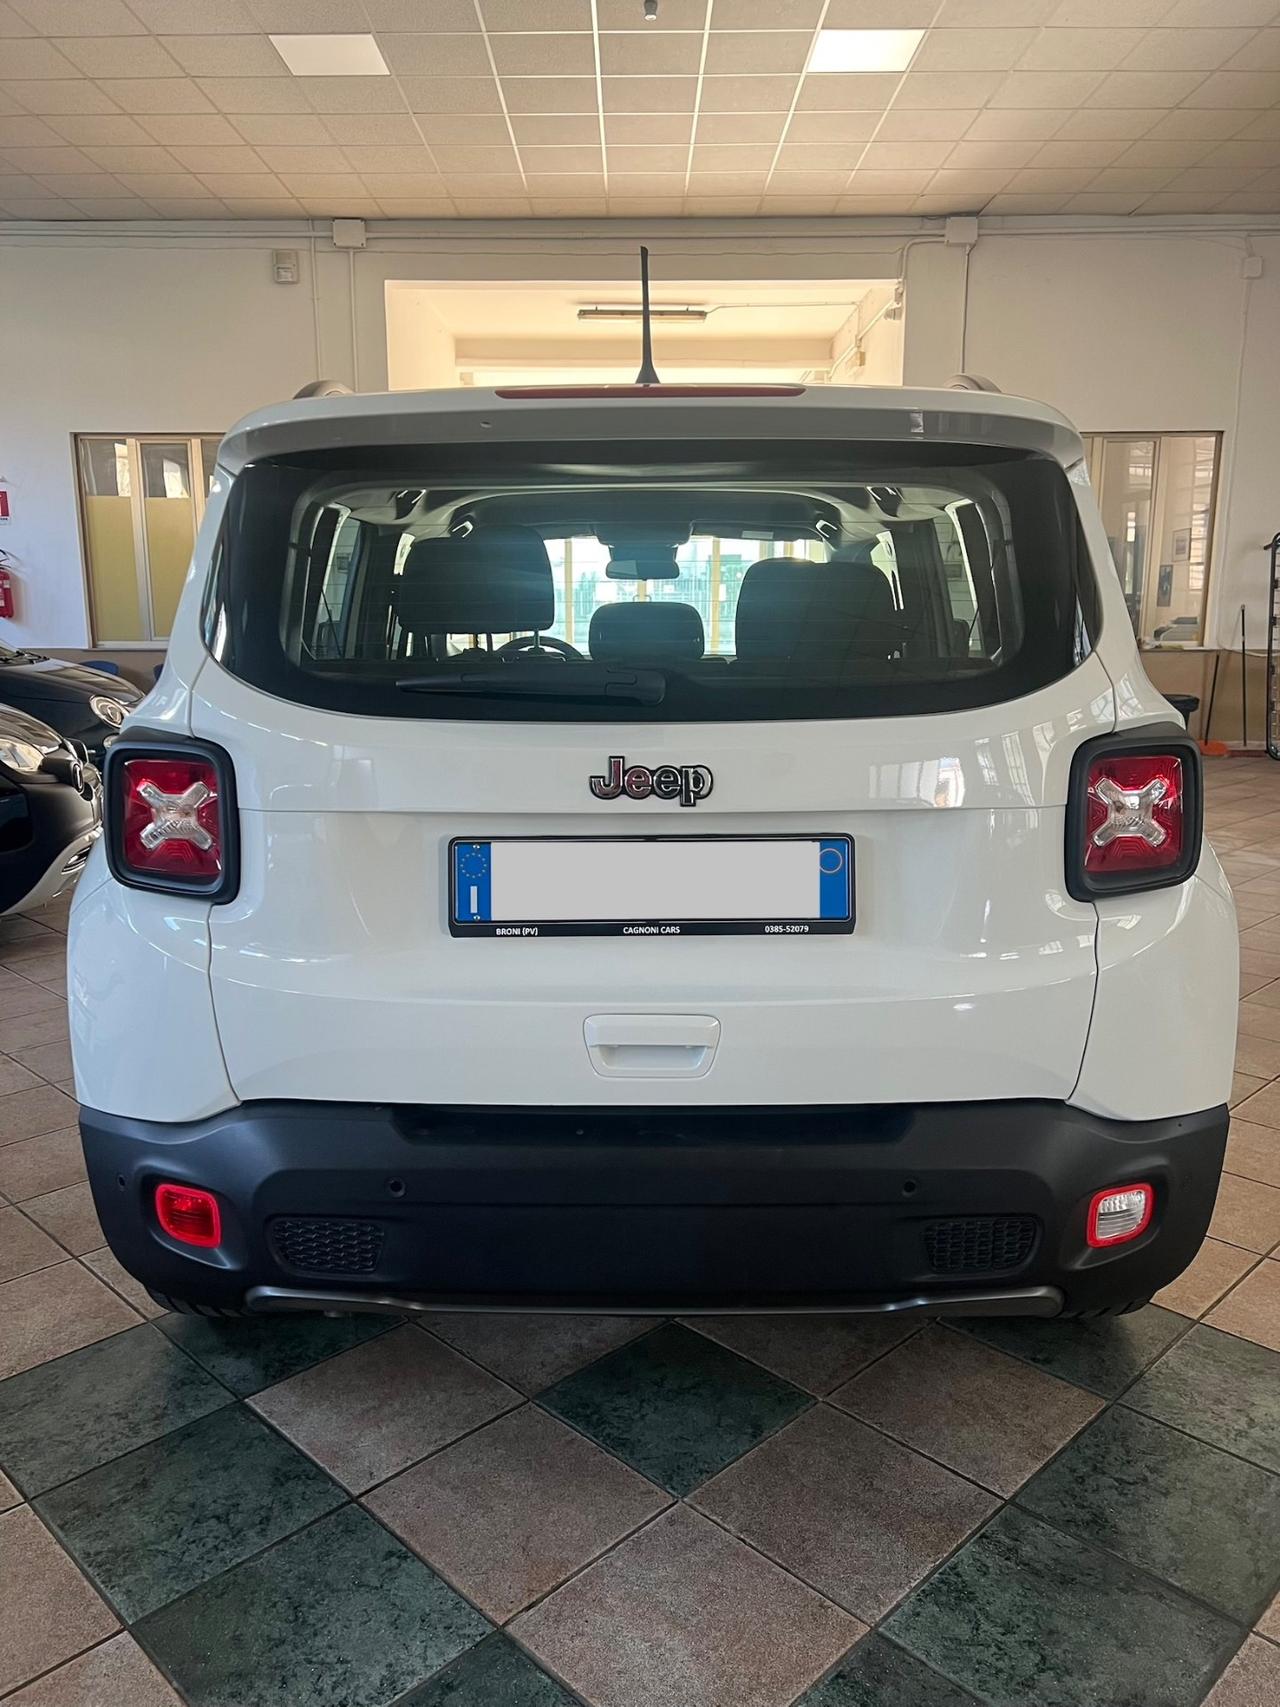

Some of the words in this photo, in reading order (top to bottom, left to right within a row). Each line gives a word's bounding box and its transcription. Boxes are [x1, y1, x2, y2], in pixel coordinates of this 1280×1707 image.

[589, 756, 713, 807] Jeep
[470, 885, 478, 913] I
[495, 928, 521, 936] BRONI
[522, 927, 539, 937] (PV)
[623, 926, 659, 934] CAGNONI
[660, 926, 681, 934] CARS
[764, 925, 810, 934] 0385-52079
